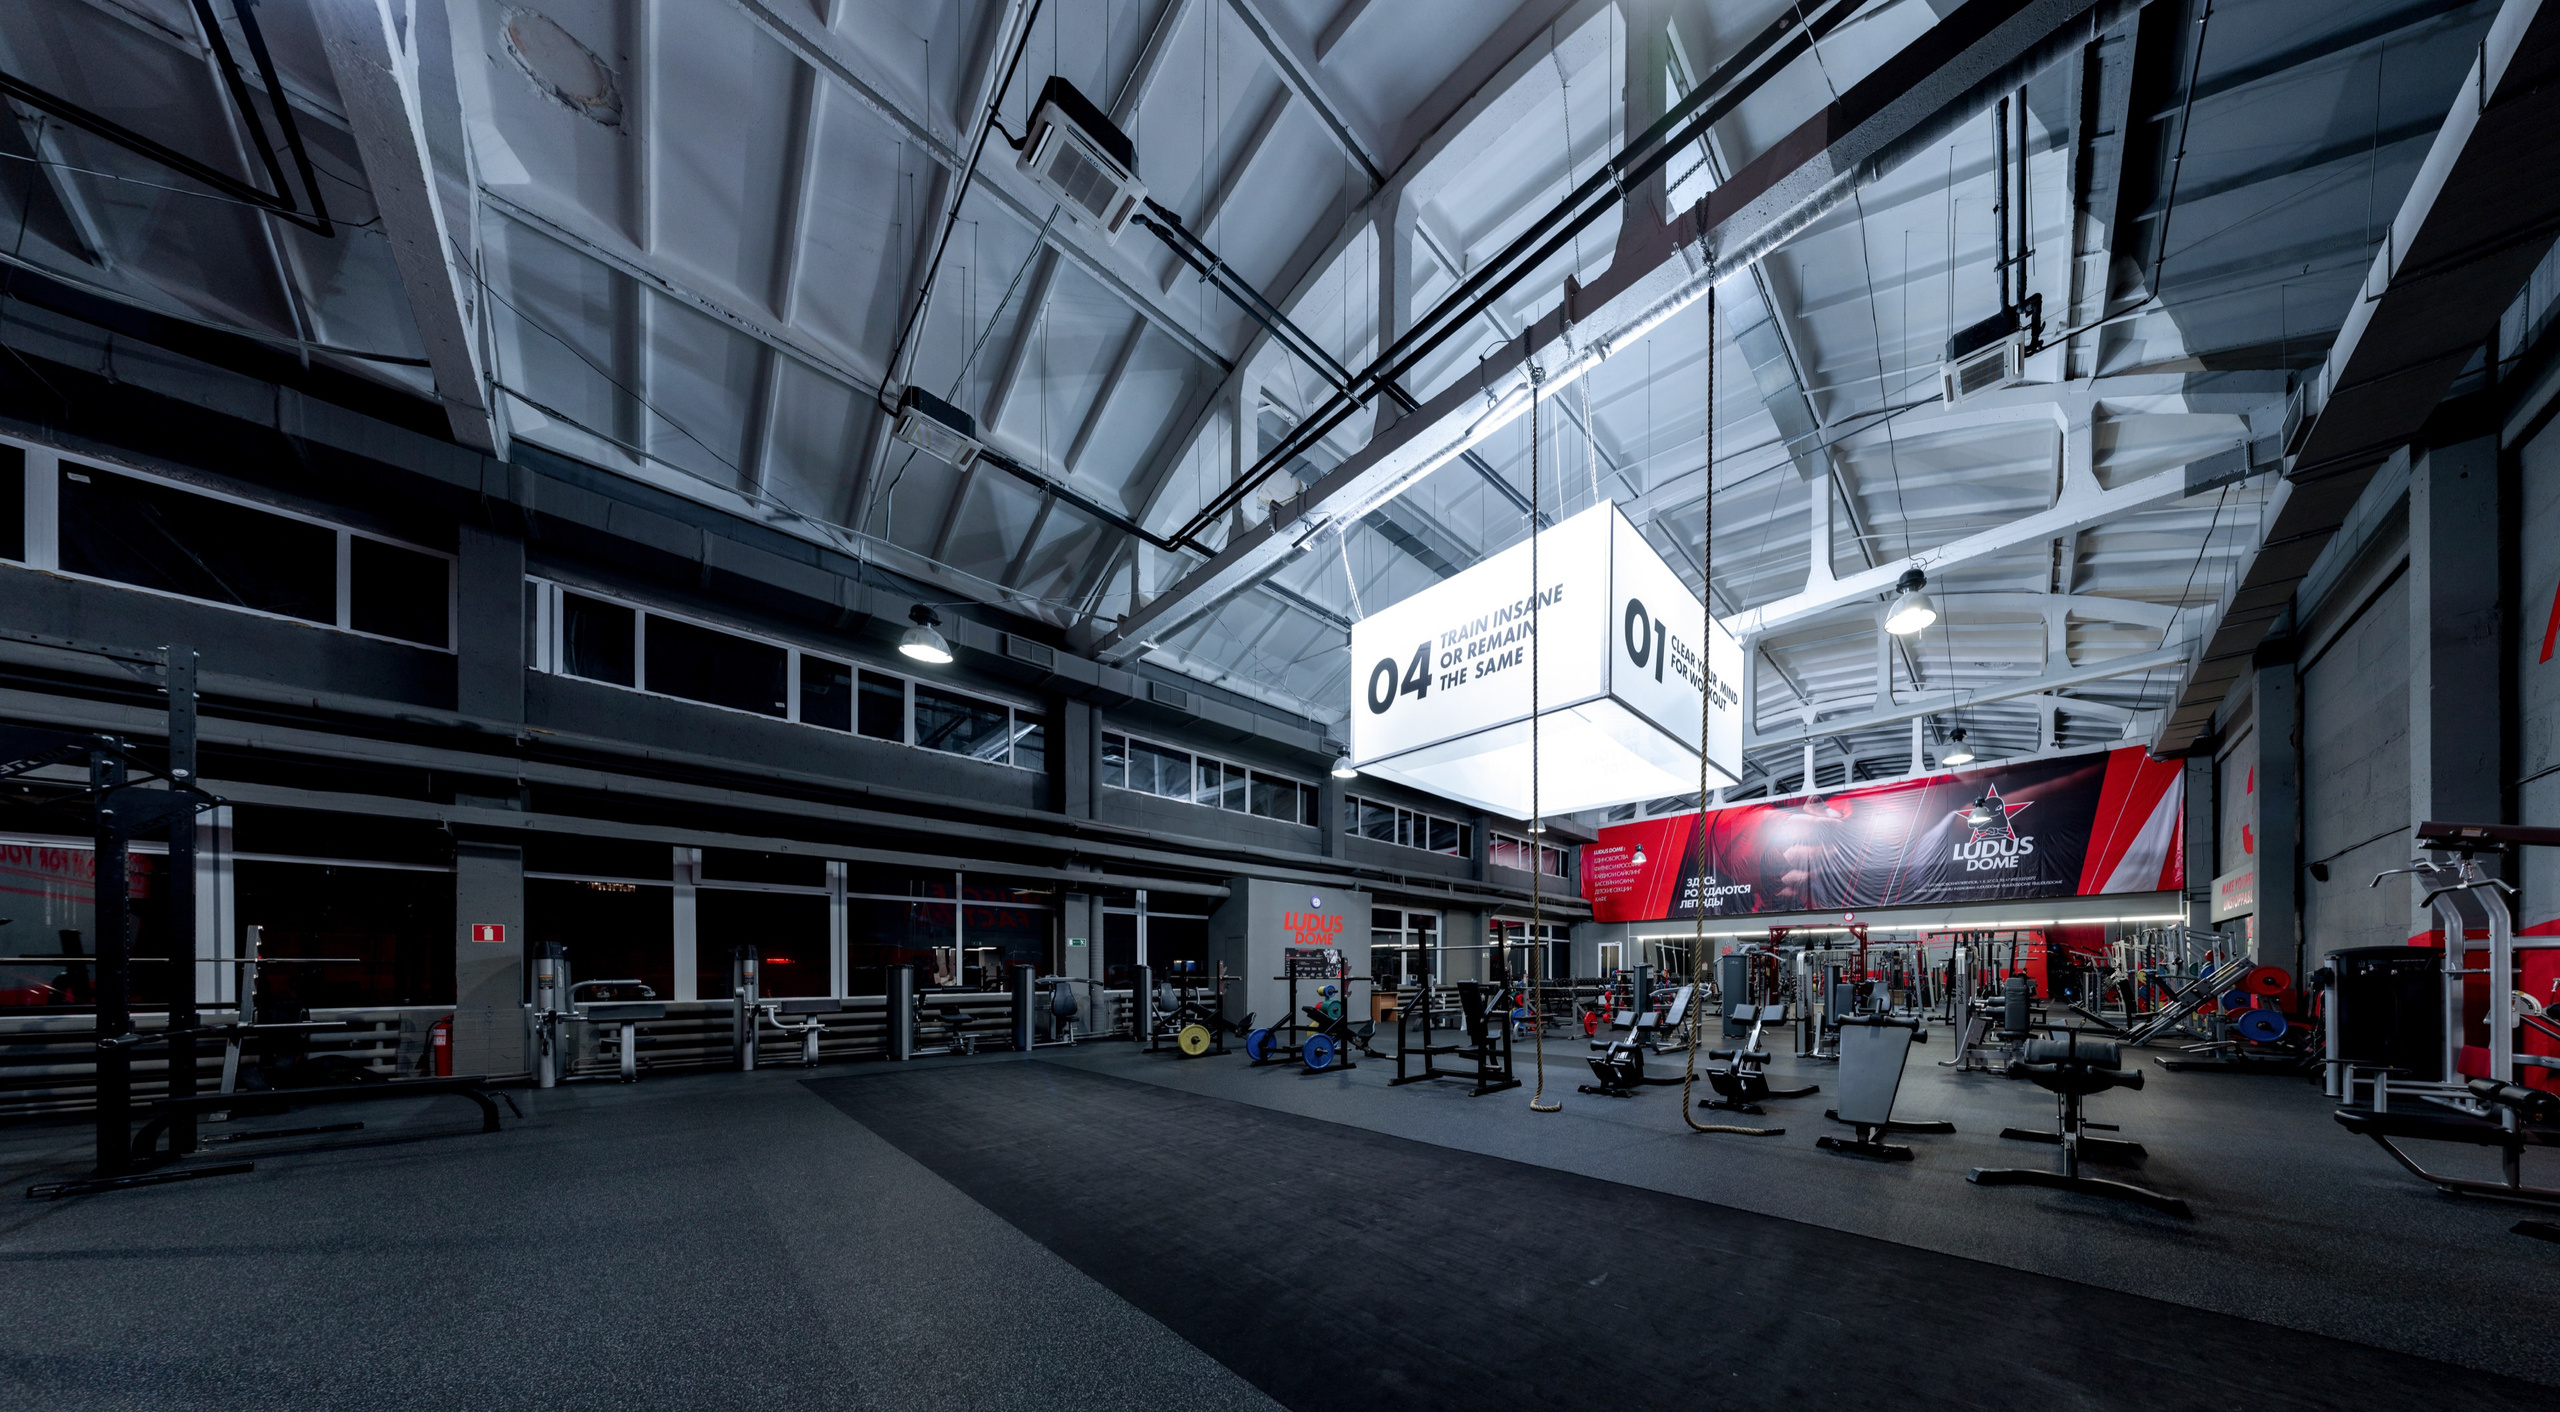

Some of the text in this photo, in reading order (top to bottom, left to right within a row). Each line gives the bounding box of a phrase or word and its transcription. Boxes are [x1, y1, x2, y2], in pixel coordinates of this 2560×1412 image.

[1440, 583, 1564, 649] TRAIN INSANE
[1440, 620, 1535, 670] OR REMAIN
[1624, 598, 1666, 684] 01
[1368, 640, 1433, 715] 04
[1440, 646, 1524, 691] THE SAME
[1671, 635, 1696, 669] CLEAR
[1720, 680, 1738, 706] MIND
[1671, 653, 1727, 712] FOR WOKOUT
[1953, 836, 2034, 861] LUDUS
[1966, 855, 2020, 872] DOME
[1687, 876, 1716, 888] ЗДСЬ
[1284, 911, 1343, 933] LUDUS
[1294, 931, 1334, 945] DOME
